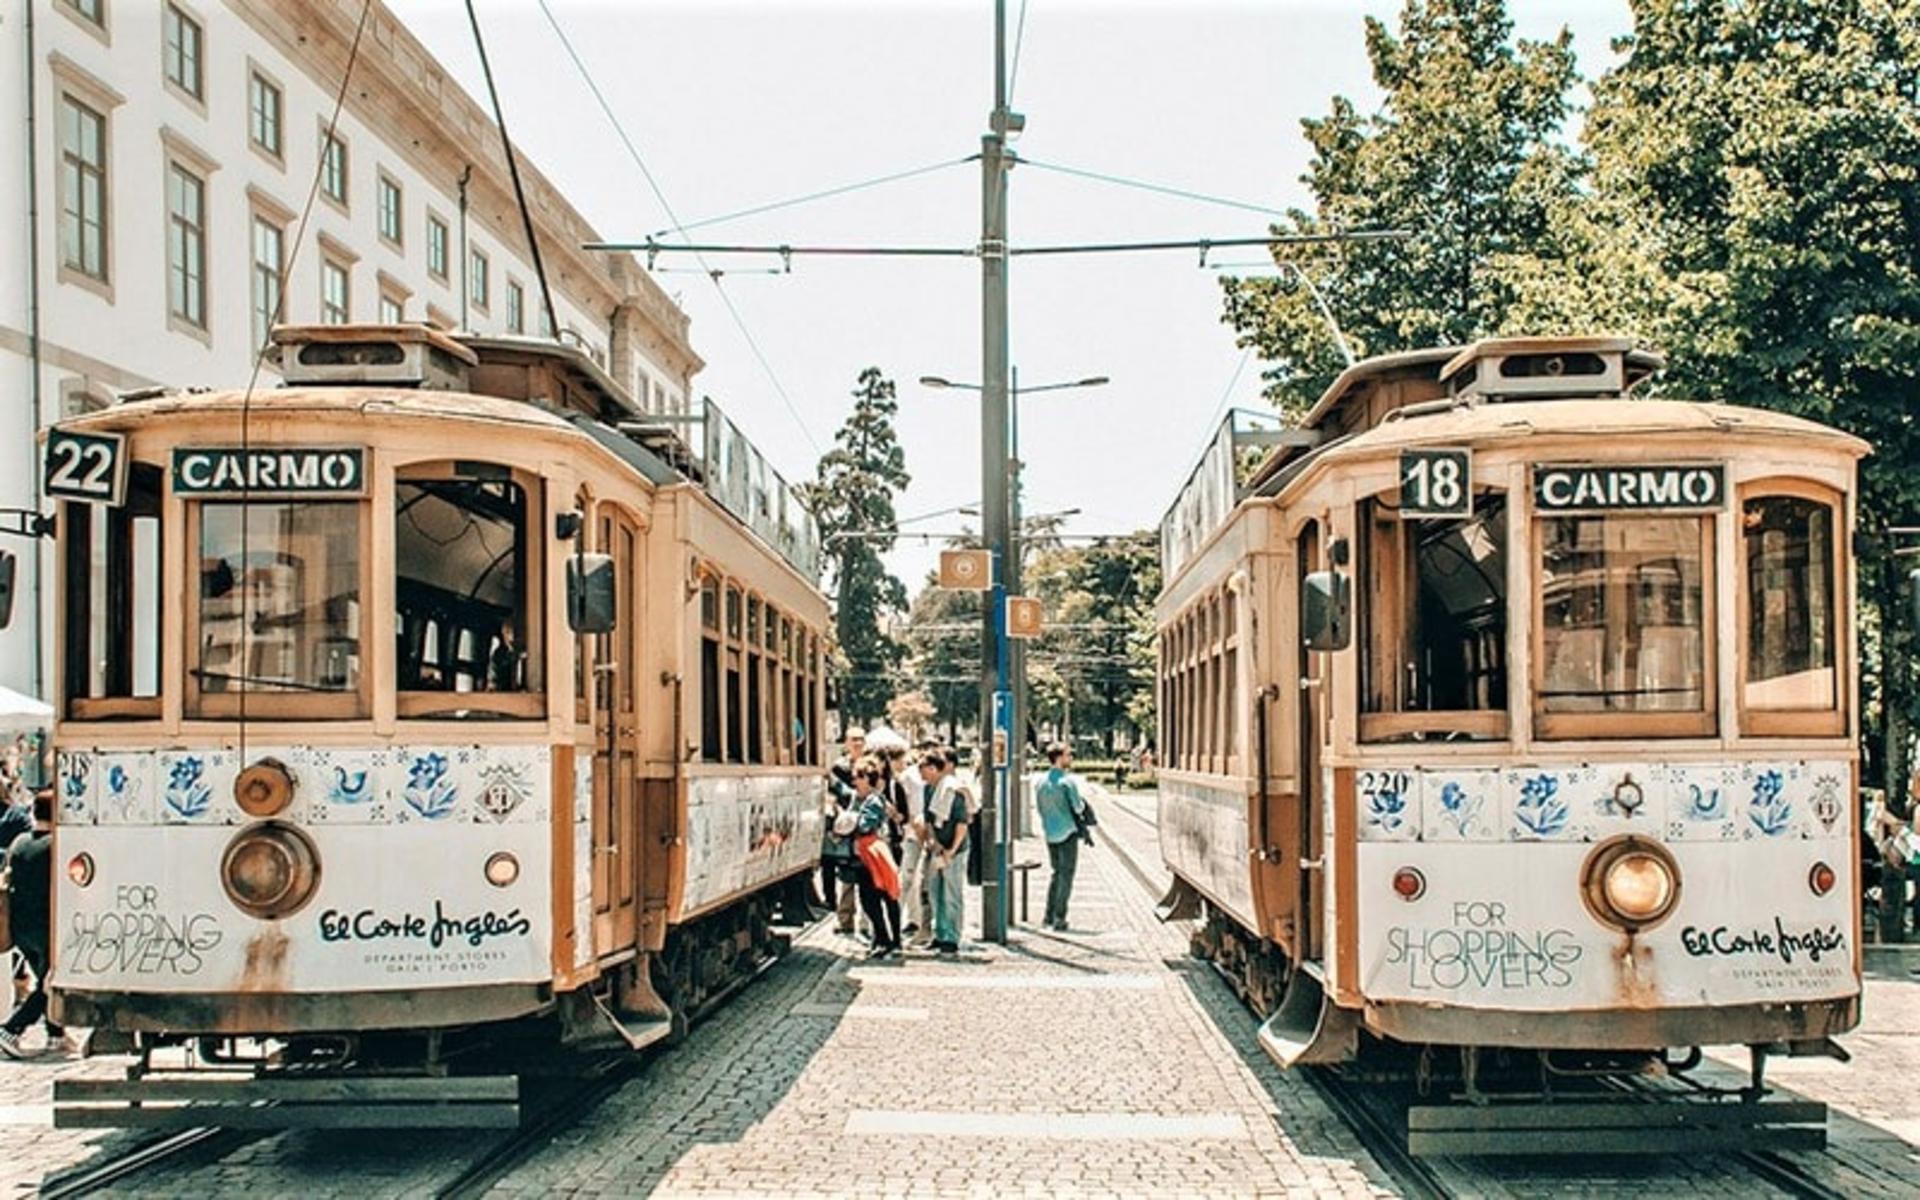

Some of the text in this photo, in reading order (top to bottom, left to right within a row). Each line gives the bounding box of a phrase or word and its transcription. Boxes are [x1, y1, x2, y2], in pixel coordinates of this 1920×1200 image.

[50, 440, 113, 492] 22
[181, 454, 355, 488] CARMO
[1407, 458, 1460, 507] 18
[1542, 470, 1716, 505] CARMO
[1361, 772, 1409, 795] 220
[116, 885, 158, 910] FOR
[1453, 902, 1506, 927] FOR
[67, 912, 223, 951] SHOPPING
[320, 900, 530, 948] El Corte Inglés
[1681, 926, 1713, 957] El
[1711, 926, 1776, 954] Corte
[69, 937, 203, 974] LOVERS
[364, 951, 507, 963] DEPARTMENT STORES
[1387, 927, 1583, 964] SHOPPING
[386, 962, 488, 973] GAIA PORTO
[1410, 953, 1573, 989] LOVERS
